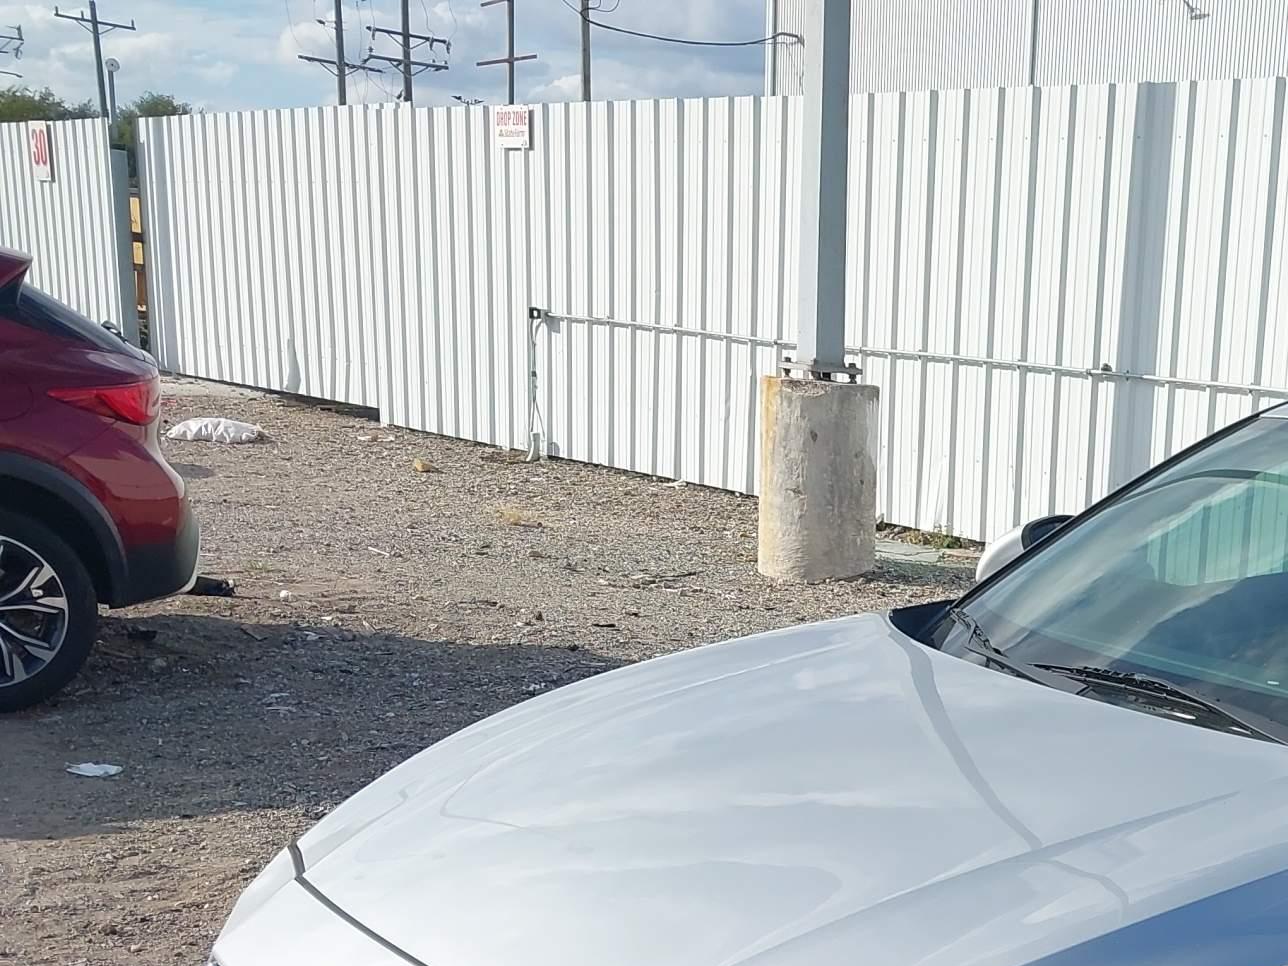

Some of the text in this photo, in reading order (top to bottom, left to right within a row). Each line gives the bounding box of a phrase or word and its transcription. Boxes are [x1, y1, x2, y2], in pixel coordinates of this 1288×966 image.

[497, 111, 527, 126] DROP ZONE
[32, 129, 48, 165] 30
